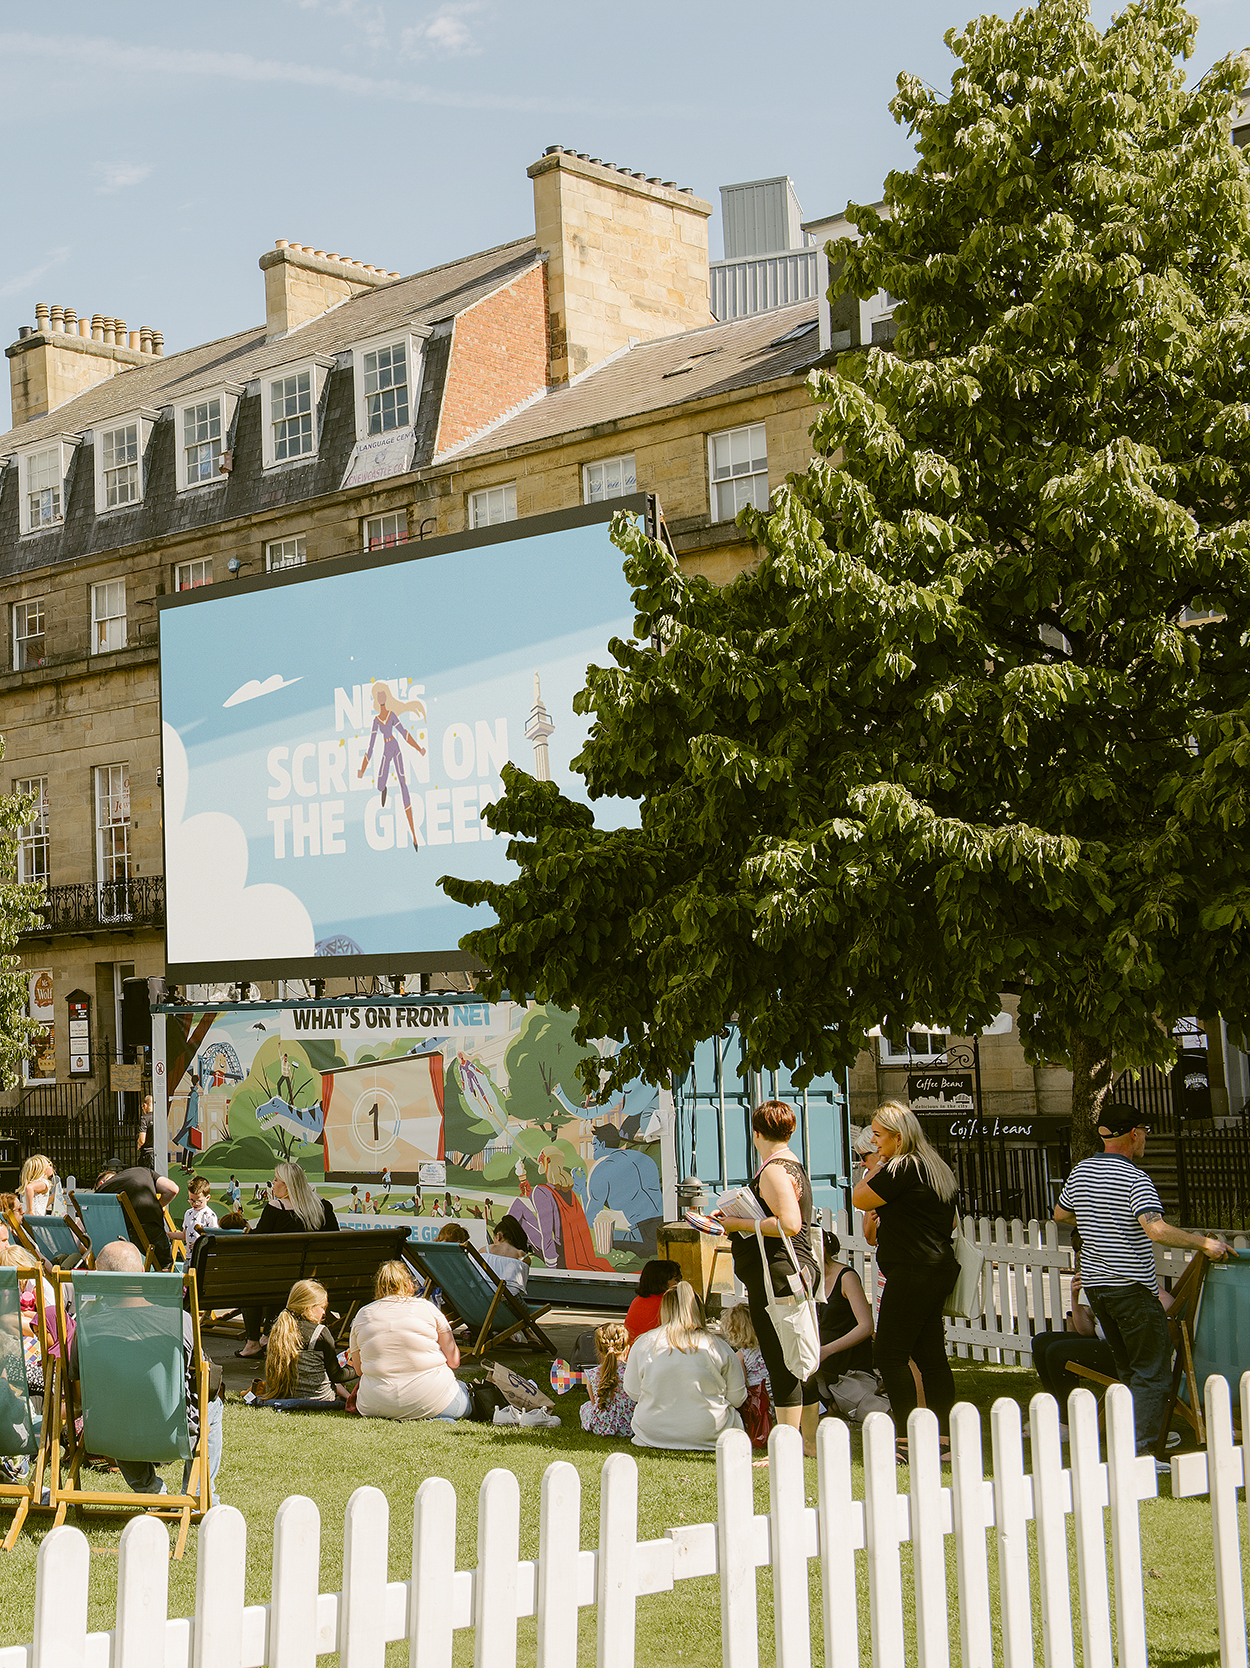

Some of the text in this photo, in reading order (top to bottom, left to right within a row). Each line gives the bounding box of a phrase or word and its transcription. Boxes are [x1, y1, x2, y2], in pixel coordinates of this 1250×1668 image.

[359, 437, 395, 452] LANGUAGE
[442, 718, 509, 780] ON
[267, 800, 347, 859] THE
[36, 988, 53, 1000] Wolf
[293, 1007, 361, 1030] WHAT'S
[365, 1007, 391, 1029] ON
[396, 1006, 449, 1028] FROM
[916, 1077, 964, 1090] Coffee Beans
[369, 1103, 379, 1141] 1
